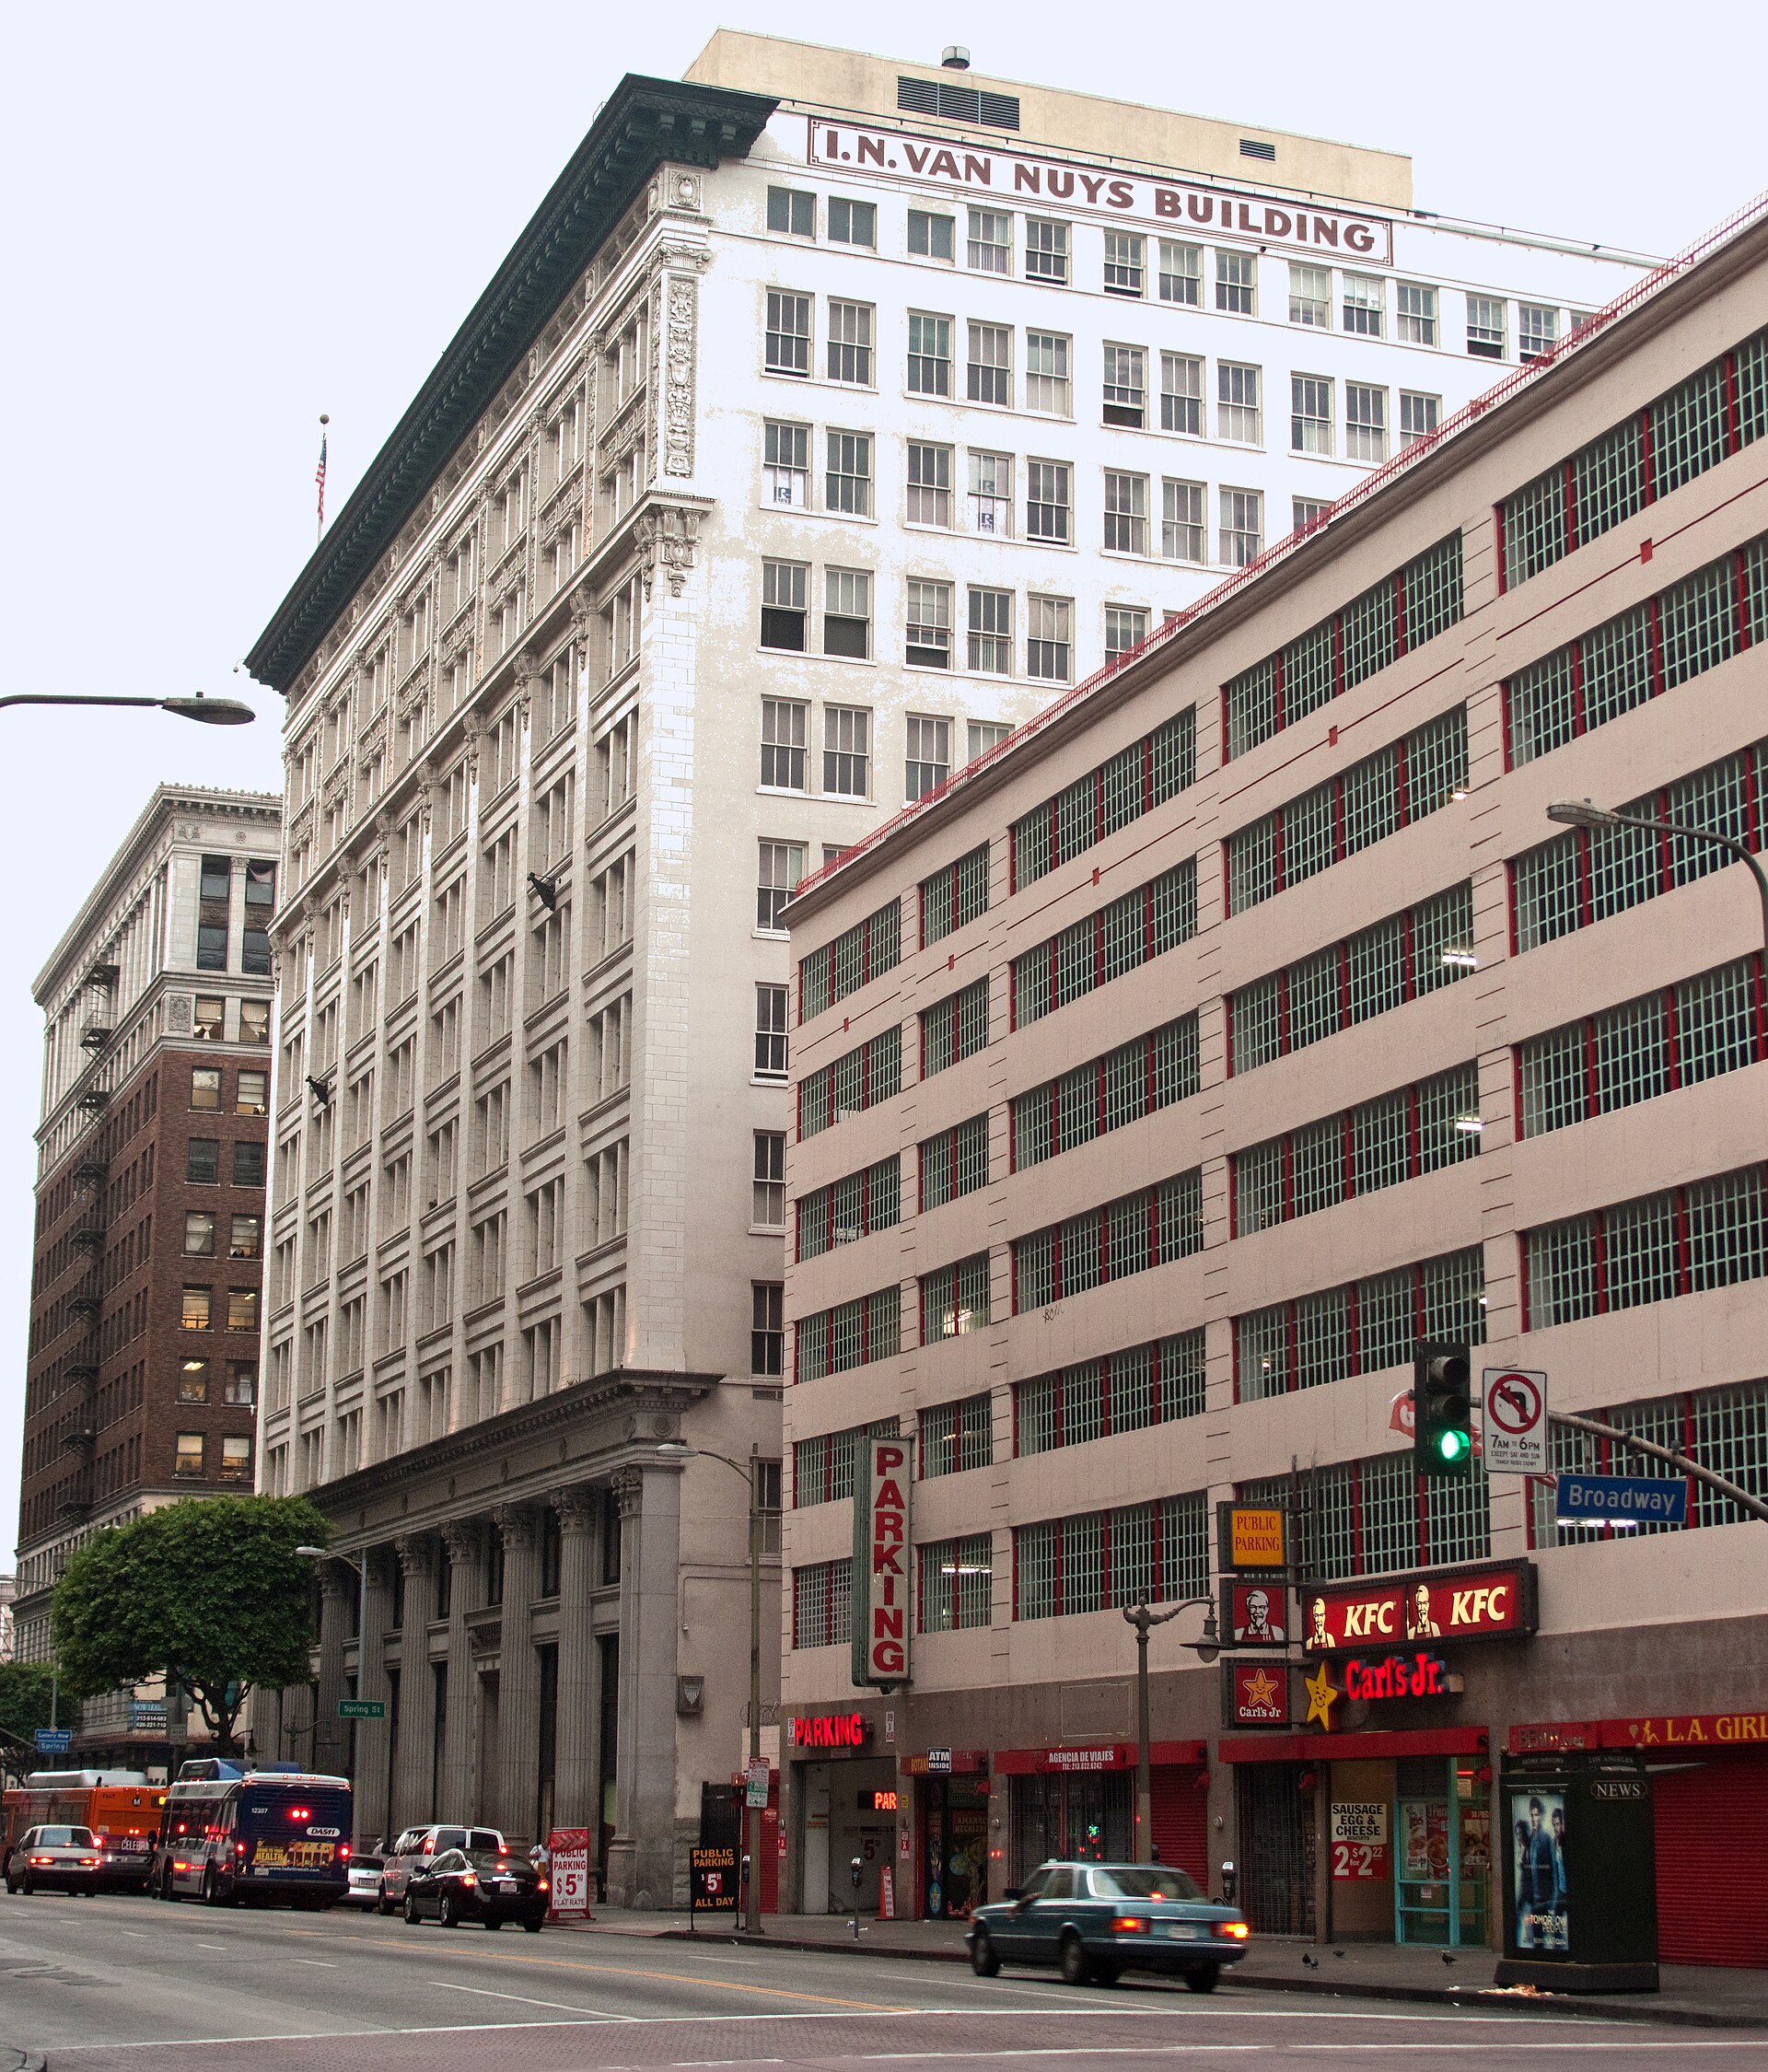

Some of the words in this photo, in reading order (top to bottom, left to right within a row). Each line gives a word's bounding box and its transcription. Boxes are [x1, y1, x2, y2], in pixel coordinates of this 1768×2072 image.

[1015, 163, 1134, 209] NUYS
[1155, 188, 1375, 253] BUILDING
[1490, 1435, 1509, 1449] 7AM
[1519, 1437, 1540, 1450] 6PM
[1569, 1484, 1676, 1515] Broadway
[1236, 1516, 1276, 1531] PUBLIC
[1235, 1536, 1280, 1552] PARKING
[872, 1446, 905, 1672] PARKING
[1449, 1586, 1506, 1625] KFC
[1343, 1601, 1395, 1637] KFC
[1345, 1657, 1406, 1701] Carl's
[1411, 1653, 1444, 1697] Jr.
[343, 1705, 368, 1716] Spring
[1239, 1705, 1267, 1718] Carl's
[1268, 1706, 1281, 1717] Jr
[795, 1713, 863, 1747] PARKING
[1667, 1719, 1708, 1741] L.A.
[1716, 1716, 1768, 1740] GIRL
[41, 1743, 65, 1752] Spring
[929, 1752, 949, 1761] ATM
[1049, 1752, 1078, 1764] AGENCIA
[1079, 1752, 1088, 1763] DE
[1089, 1751, 1114, 1762] VIAJES
[1595, 1784, 1640, 1797] NEWS
[1332, 1804, 1383, 1815] SAUSAGE
[1341, 1815, 1363, 1825] EGG
[1367, 1815, 1376, 1825] &
[1335, 1826, 1380, 1836] CHEESE
[256, 1852, 283, 1861] HEALTH
[555, 1848, 585, 1857] PUBLIC
[692, 1848, 734, 1858] PUBLIC
[553, 1860, 587, 1871] PARKING
[693, 1857, 735, 1868] PARKING
[1334, 1845, 1349, 1876] 2
[553, 1898, 568, 1906] FLAT
[569, 1898, 586, 1906] RATE
[694, 1898, 714, 1908] ALL
[715, 1897, 735, 1906] DAY
